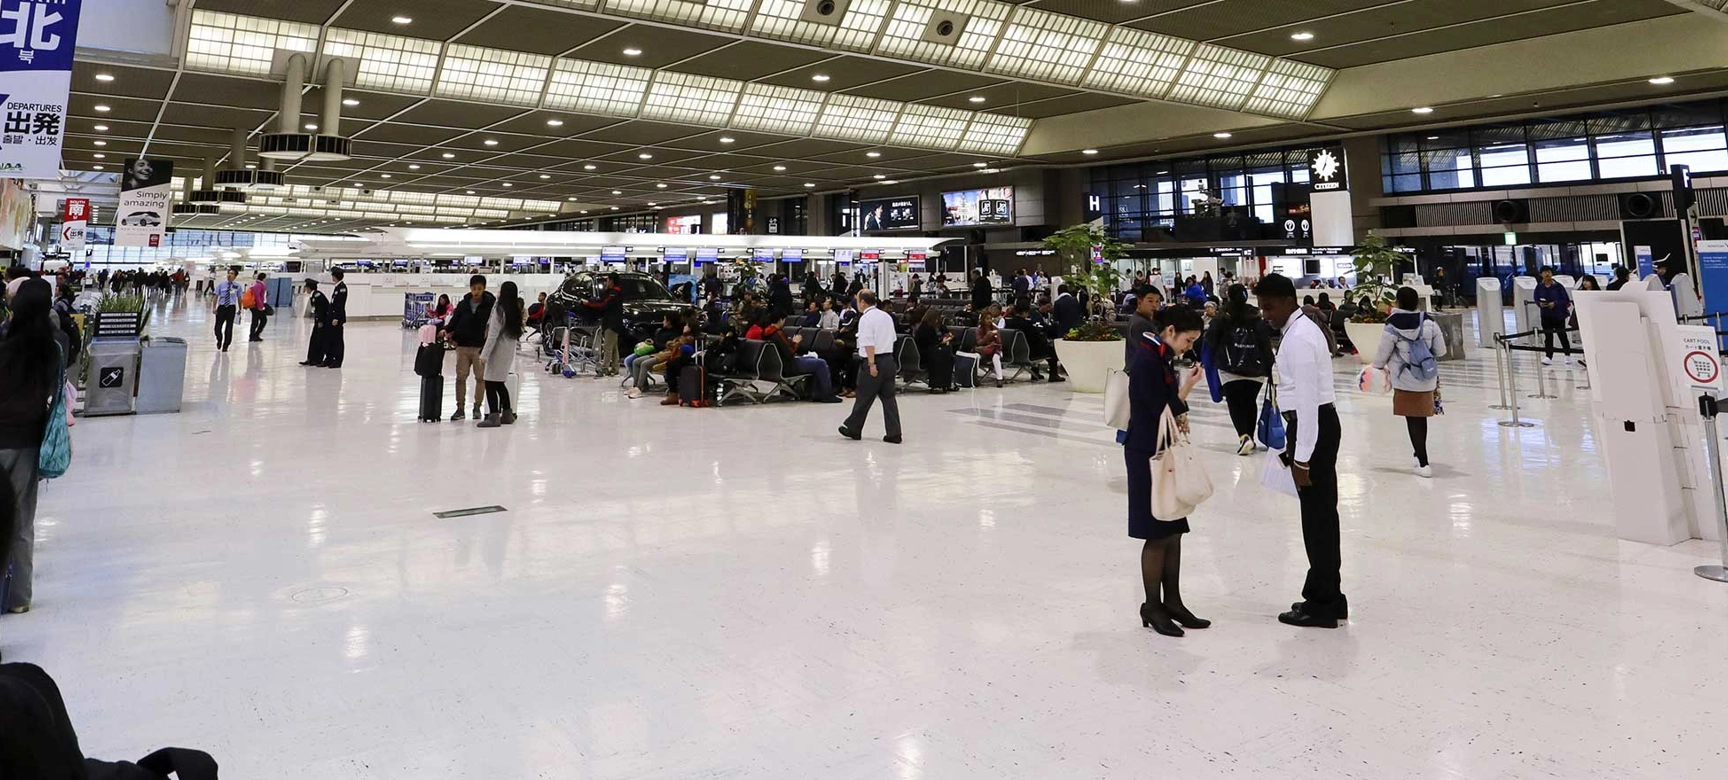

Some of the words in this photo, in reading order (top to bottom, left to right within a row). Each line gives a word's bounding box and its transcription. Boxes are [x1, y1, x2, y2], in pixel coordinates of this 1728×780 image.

[0, 2, 63, 50] 北
[18, 49, 34, 64] 북
[7, 102, 62, 112] DEPARTURES
[4, 111, 60, 135] 出発
[1682, 168, 1690, 188] F
[136, 191, 168, 200] Simply
[1089, 195, 1100, 211] H
[123, 199, 165, 209] amazing
